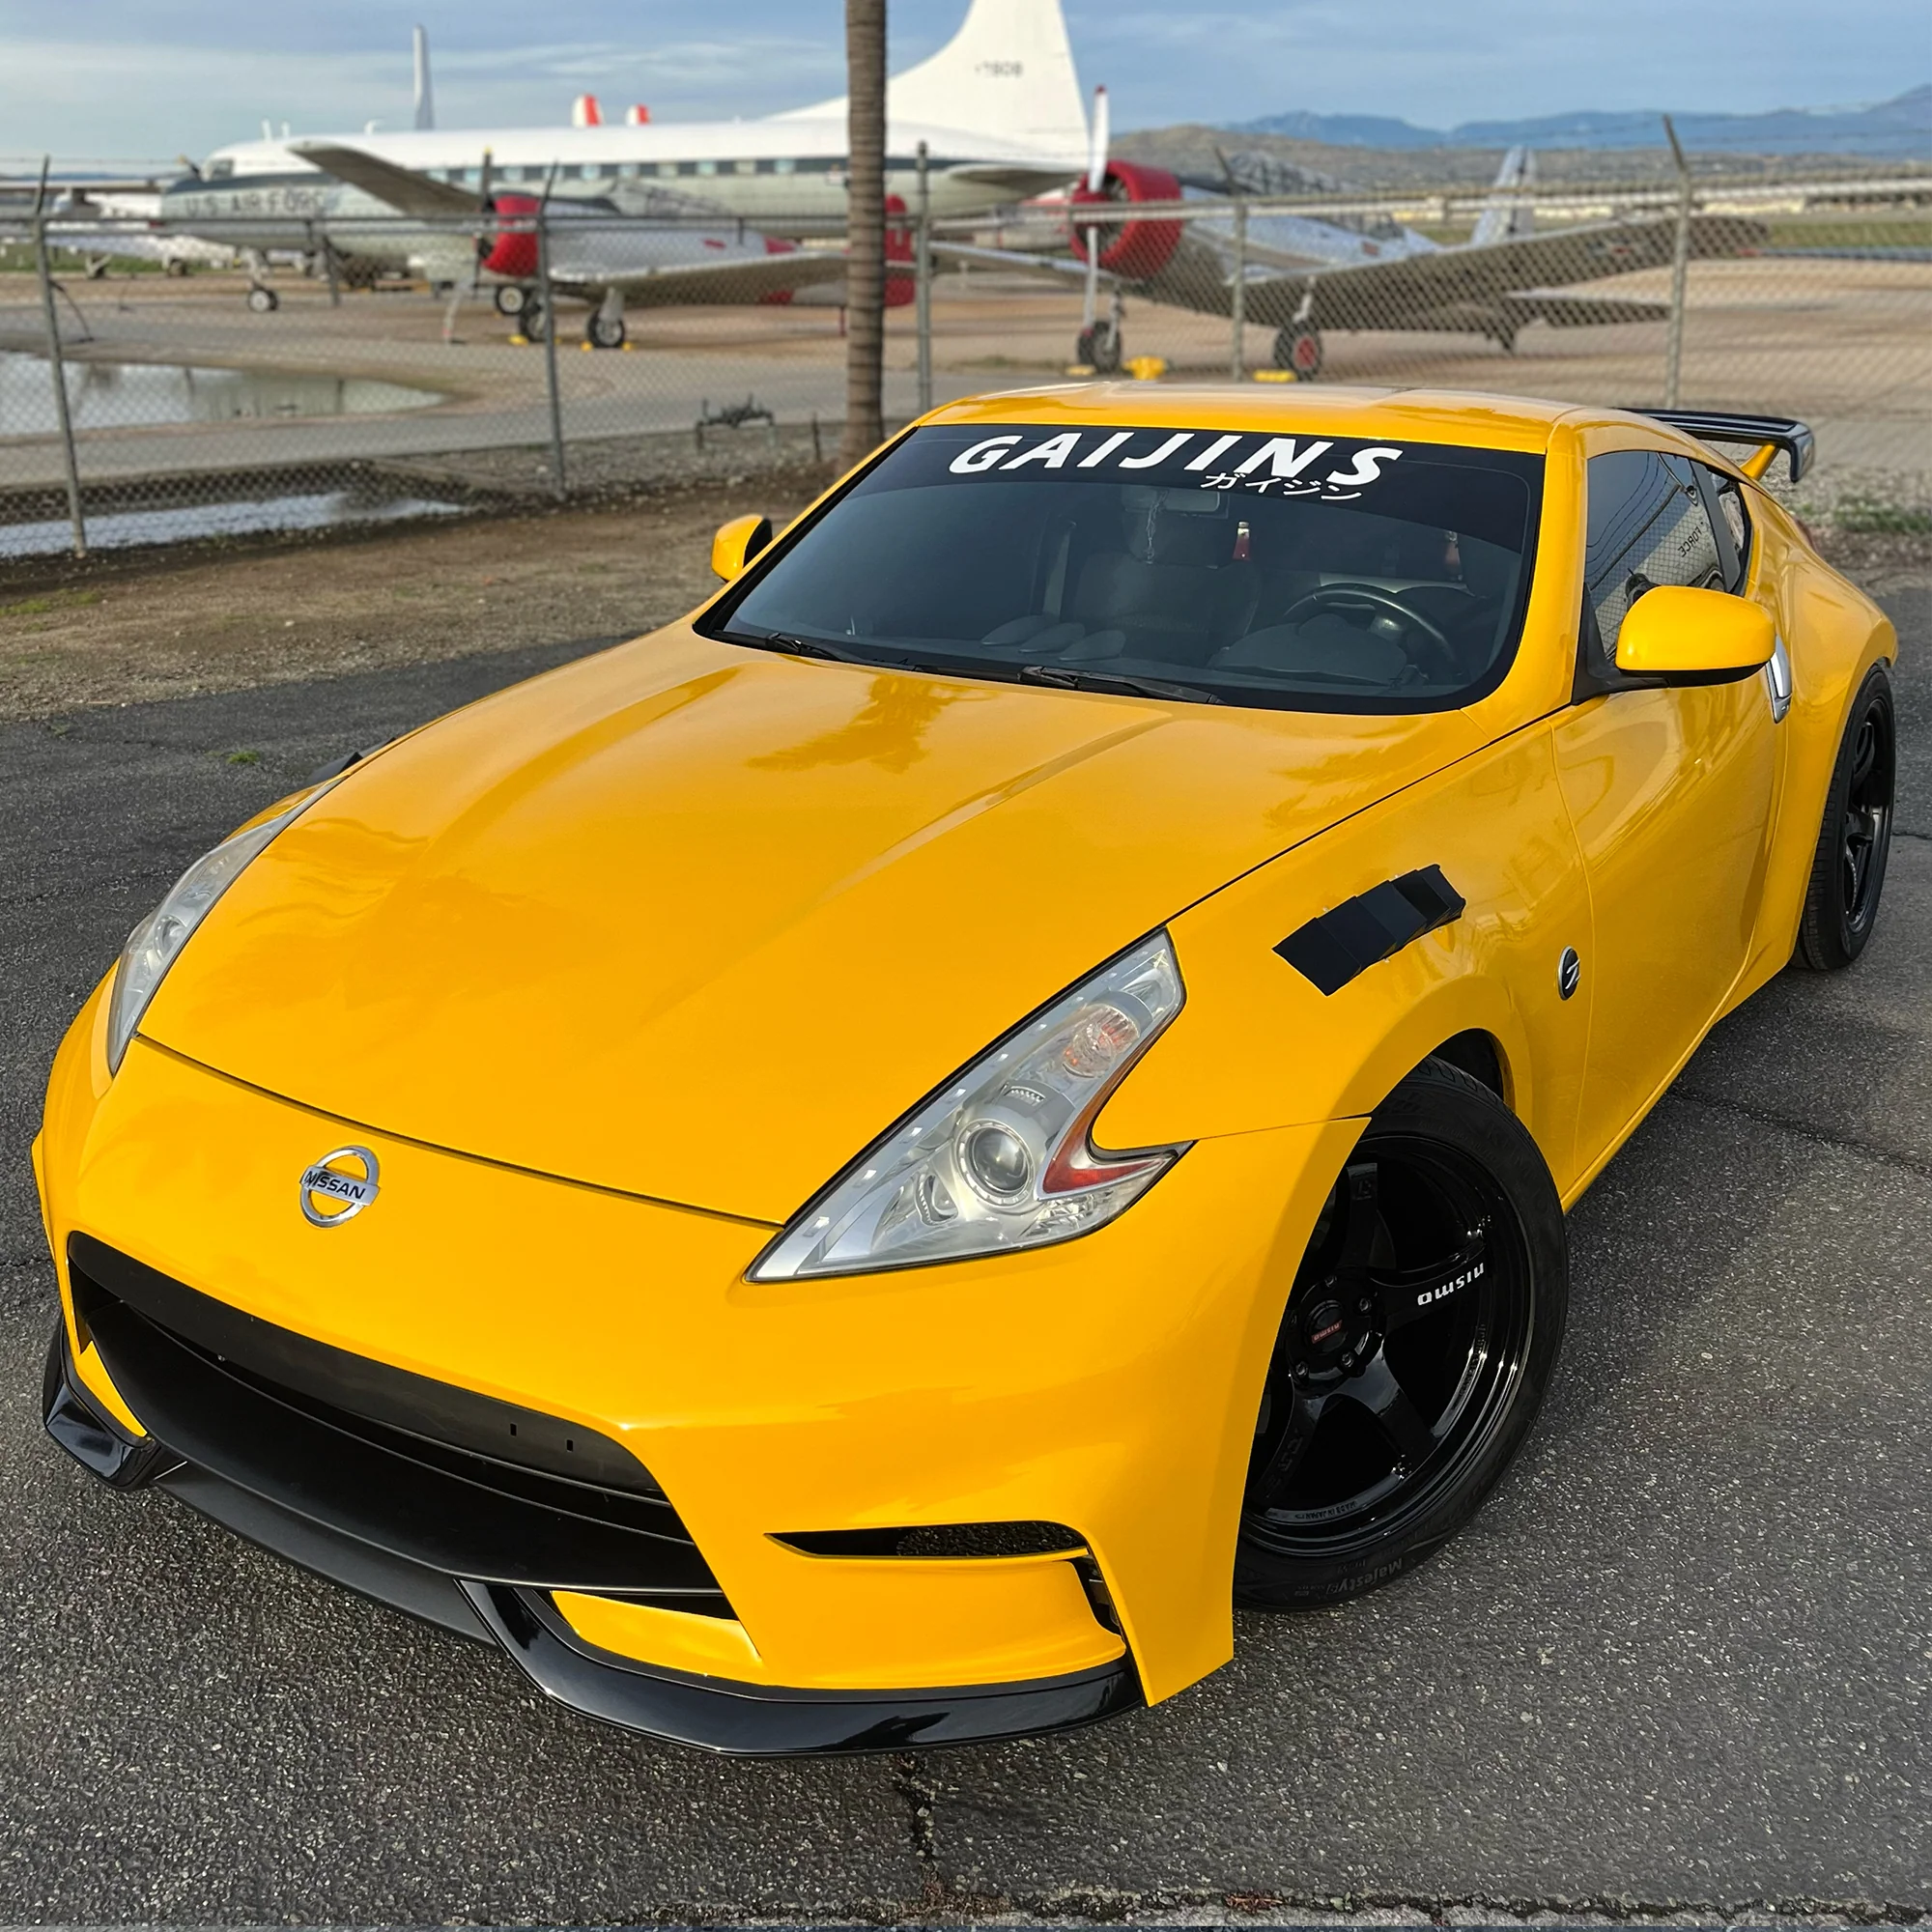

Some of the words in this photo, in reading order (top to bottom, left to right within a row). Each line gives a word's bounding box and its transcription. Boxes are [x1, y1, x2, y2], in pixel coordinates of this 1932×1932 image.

[949, 431, 1404, 487] GAIJINS
[1201, 471, 1362, 501] ガイジン
[304, 1170, 366, 1200] NISSAN
